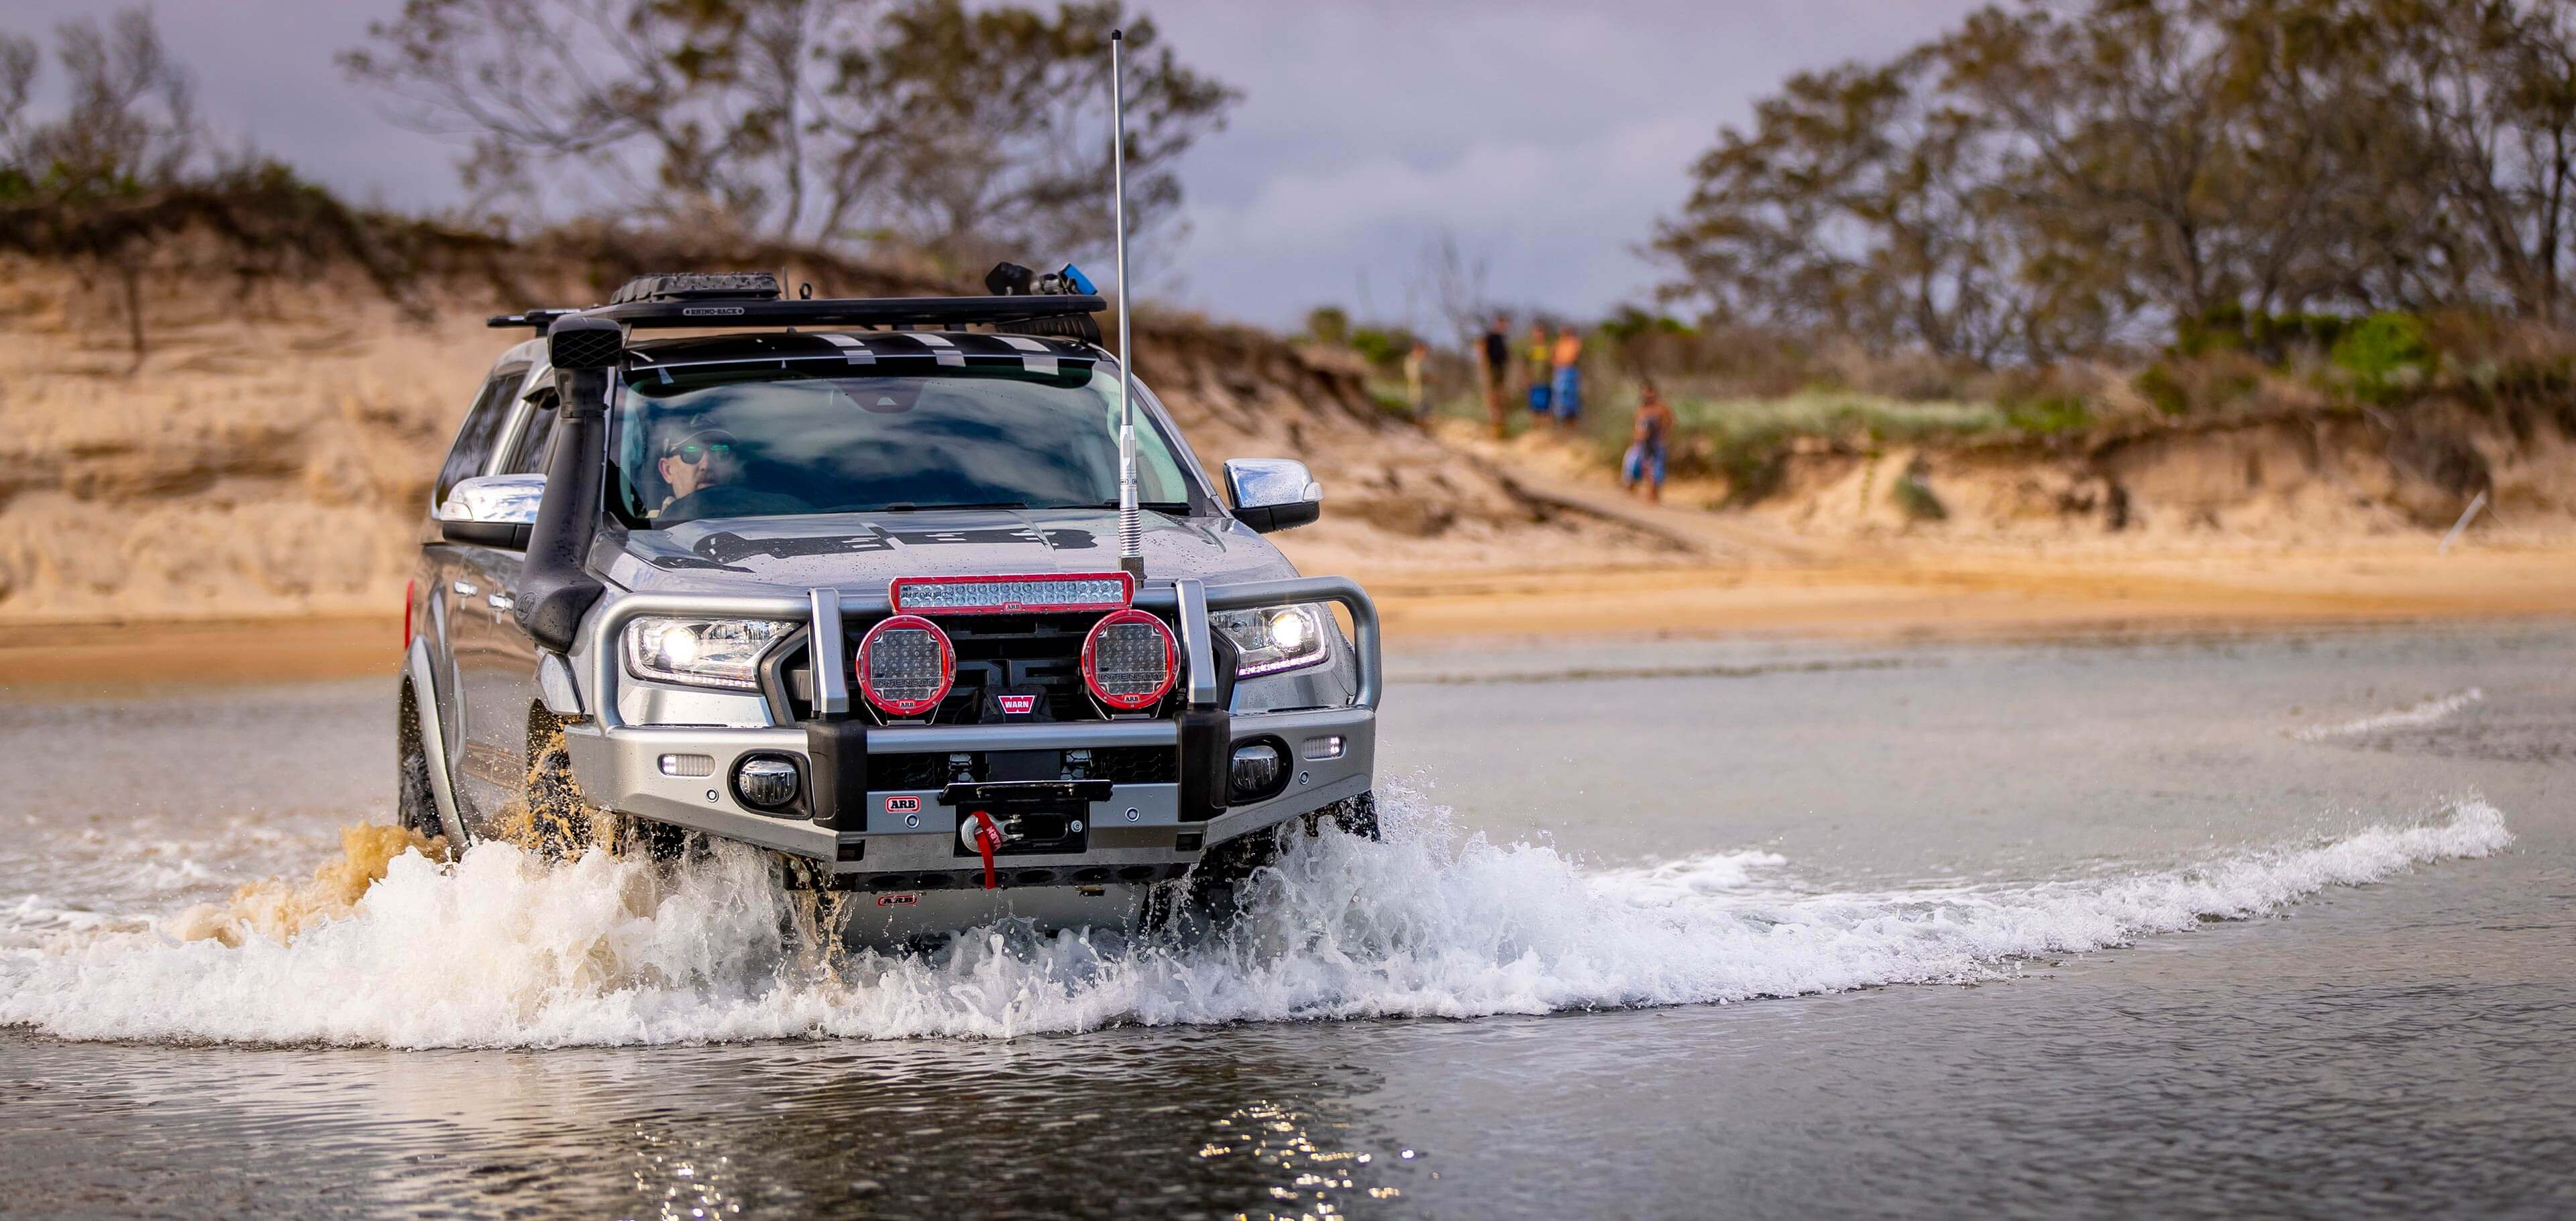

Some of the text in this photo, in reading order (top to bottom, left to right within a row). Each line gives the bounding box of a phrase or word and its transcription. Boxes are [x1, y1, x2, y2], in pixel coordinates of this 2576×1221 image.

[901, 590, 957, 598] INTENSITY
[1100, 672, 1164, 681] INTENSITY
[874, 678, 939, 688] INTENSITY
[1004, 700, 1029, 708] WARN
[890, 800, 916, 809] ARB
